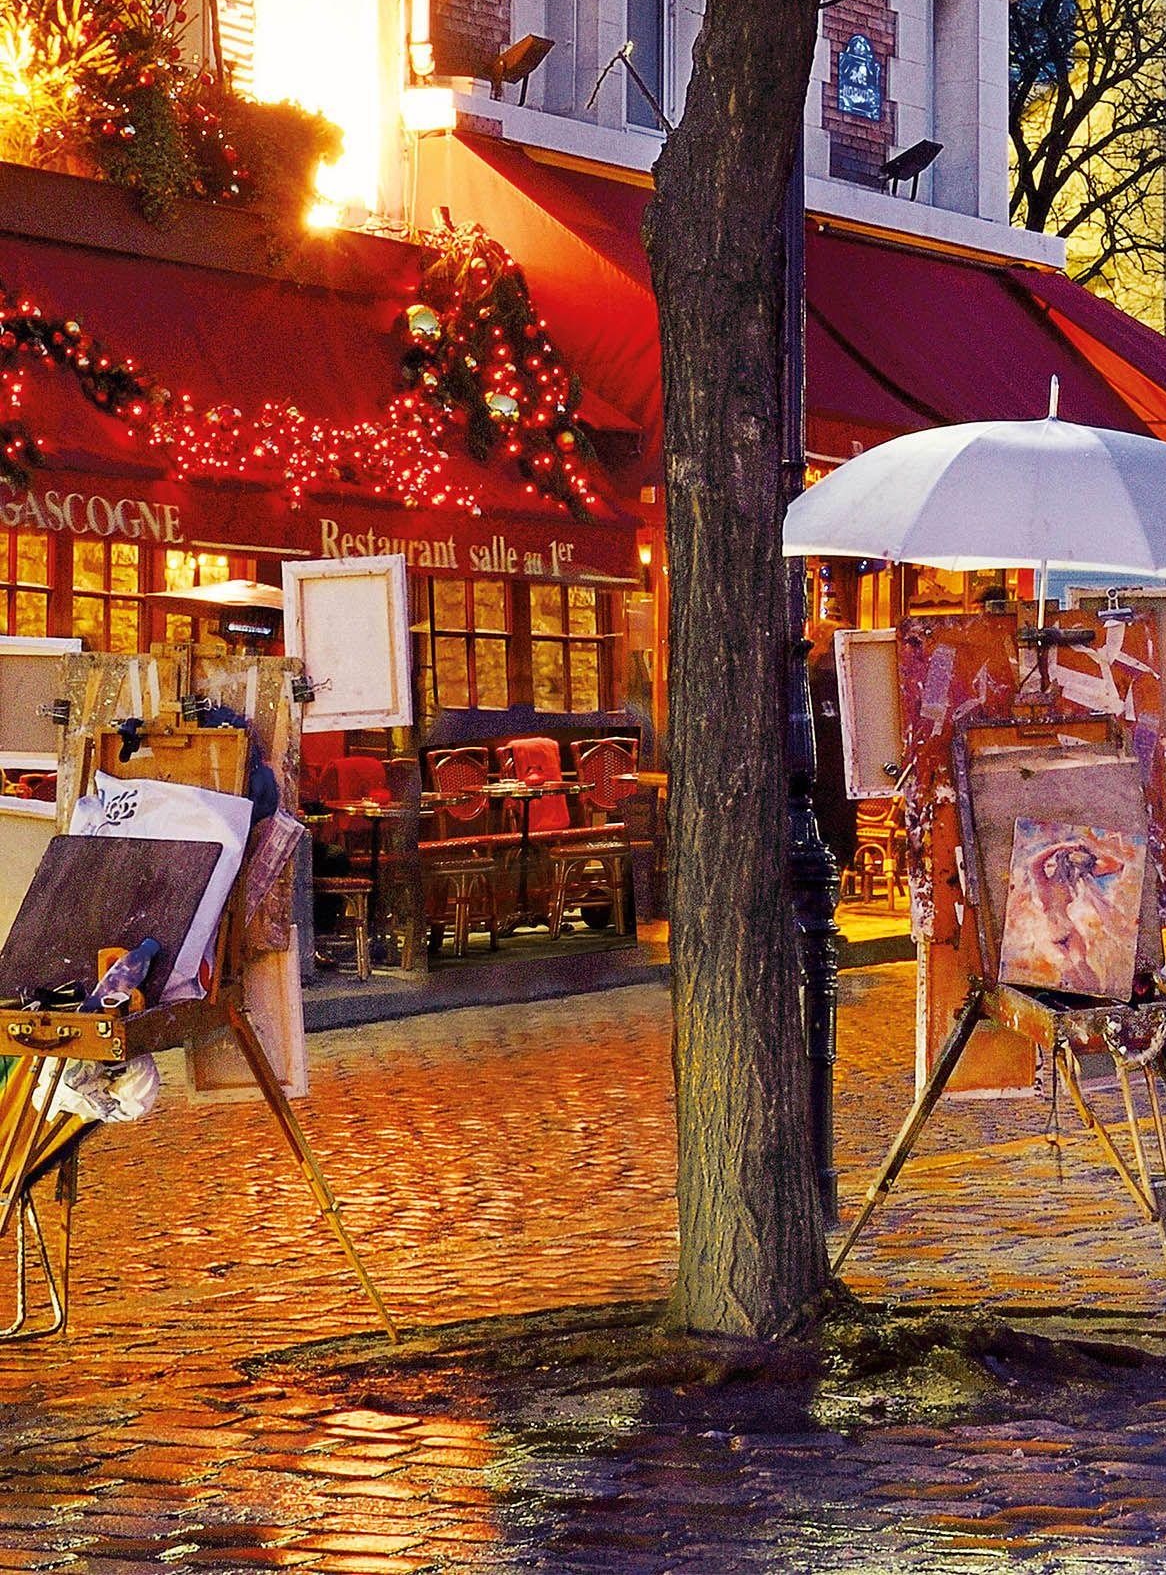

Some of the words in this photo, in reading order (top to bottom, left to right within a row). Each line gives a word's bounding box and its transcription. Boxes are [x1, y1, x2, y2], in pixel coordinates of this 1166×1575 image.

[319, 518, 458, 569] Restaurant
[469, 535, 518, 574] salle
[523, 551, 543, 576] au
